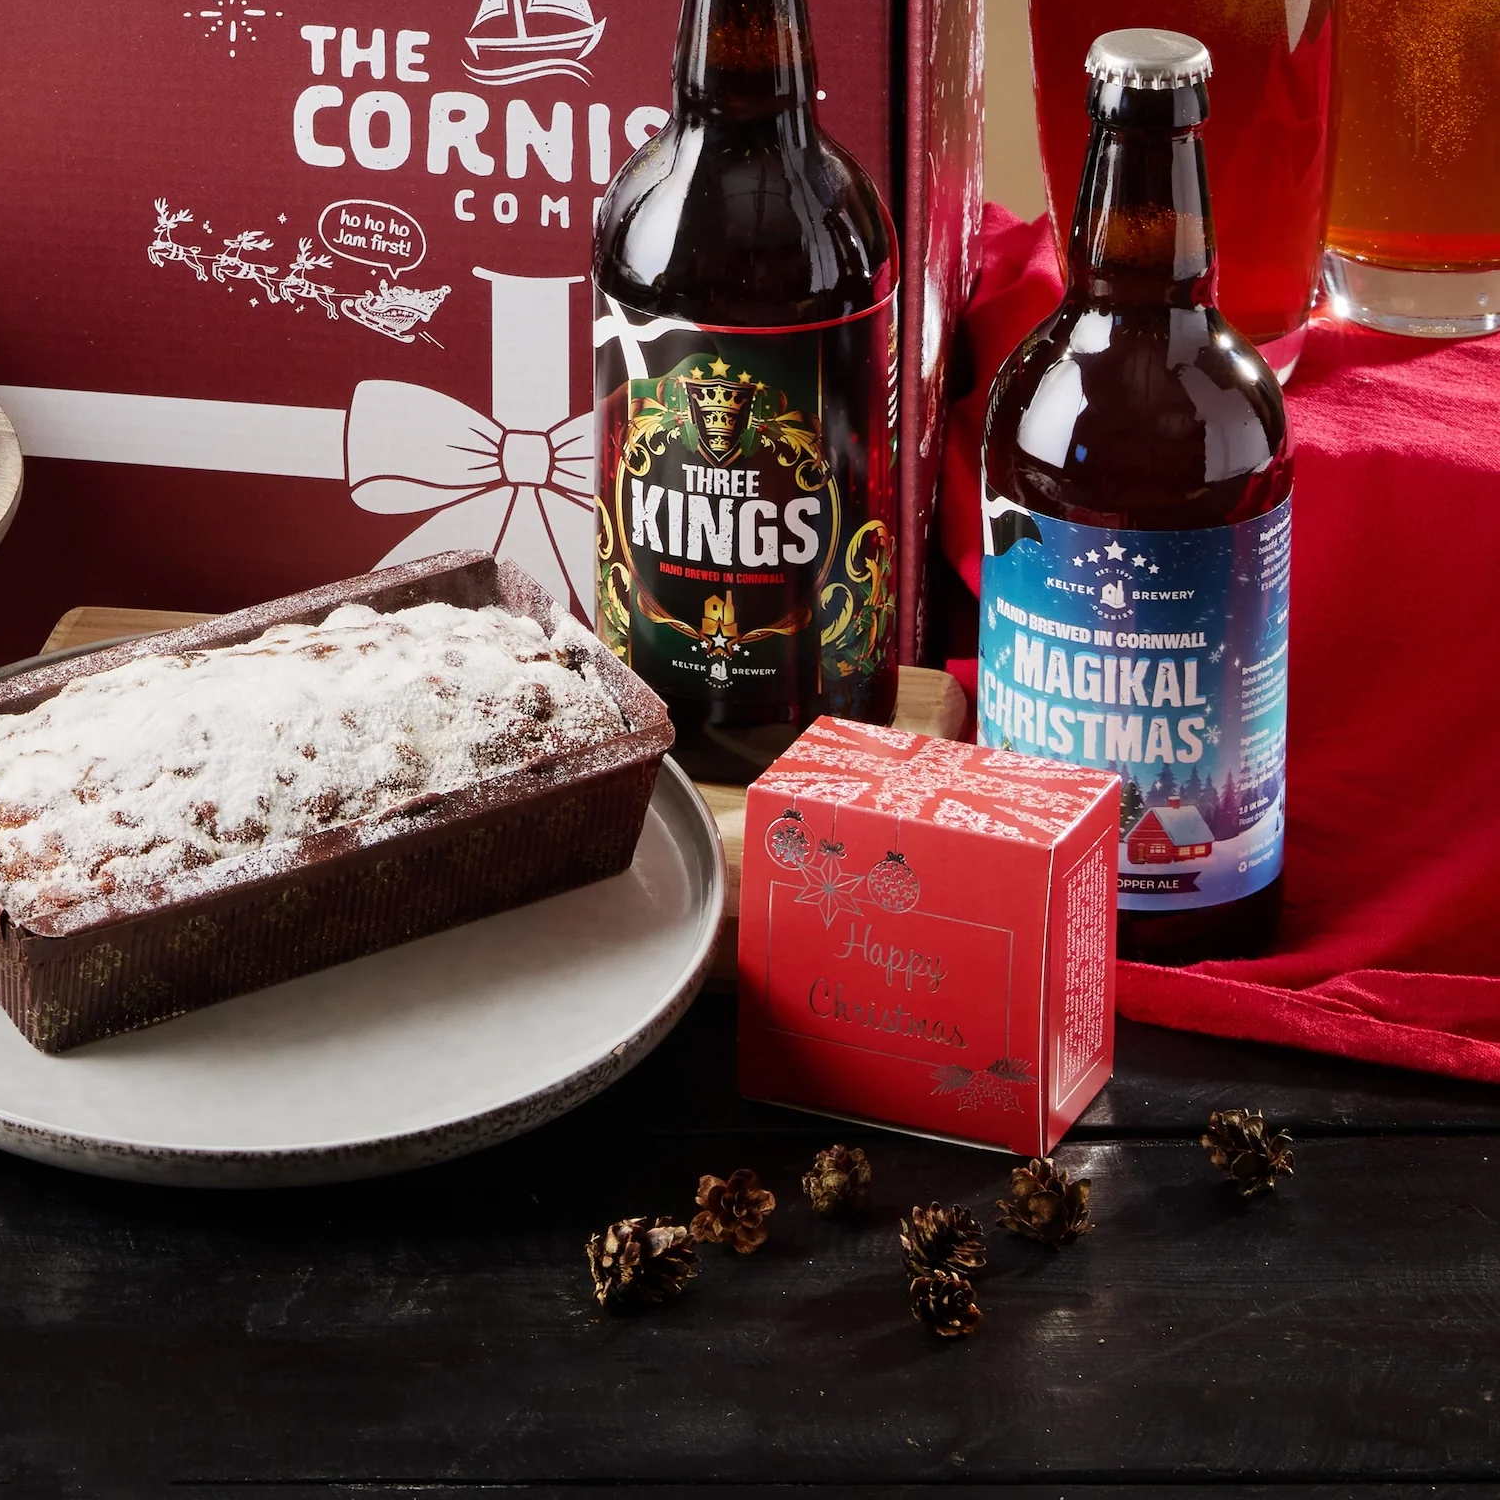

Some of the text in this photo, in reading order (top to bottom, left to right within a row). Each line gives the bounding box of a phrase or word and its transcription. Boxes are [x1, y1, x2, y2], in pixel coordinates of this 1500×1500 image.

[300, 24, 431, 82] THE
[332, 228, 412, 258] Jam first!
[340, 208, 410, 237] ho ho ho
[681, 463, 761, 498] THREE
[631, 478, 822, 568] KINGS
[660, 561, 786, 584] HAND BREWED IN CORNWALL
[1046, 576, 1195, 601] KELTEK BREWERY
[996, 597, 1207, 650] HAND BREWED IN CORNWALL
[671, 659, 707, 672] KELTEK
[1013, 628, 1207, 708] MAGIKAL
[983, 667, 1206, 764] CHRISTMAS
[1157, 879, 1180, 889] ALE
[833, 922, 948, 993] Happy
[809, 978, 969, 1049] Christmas
